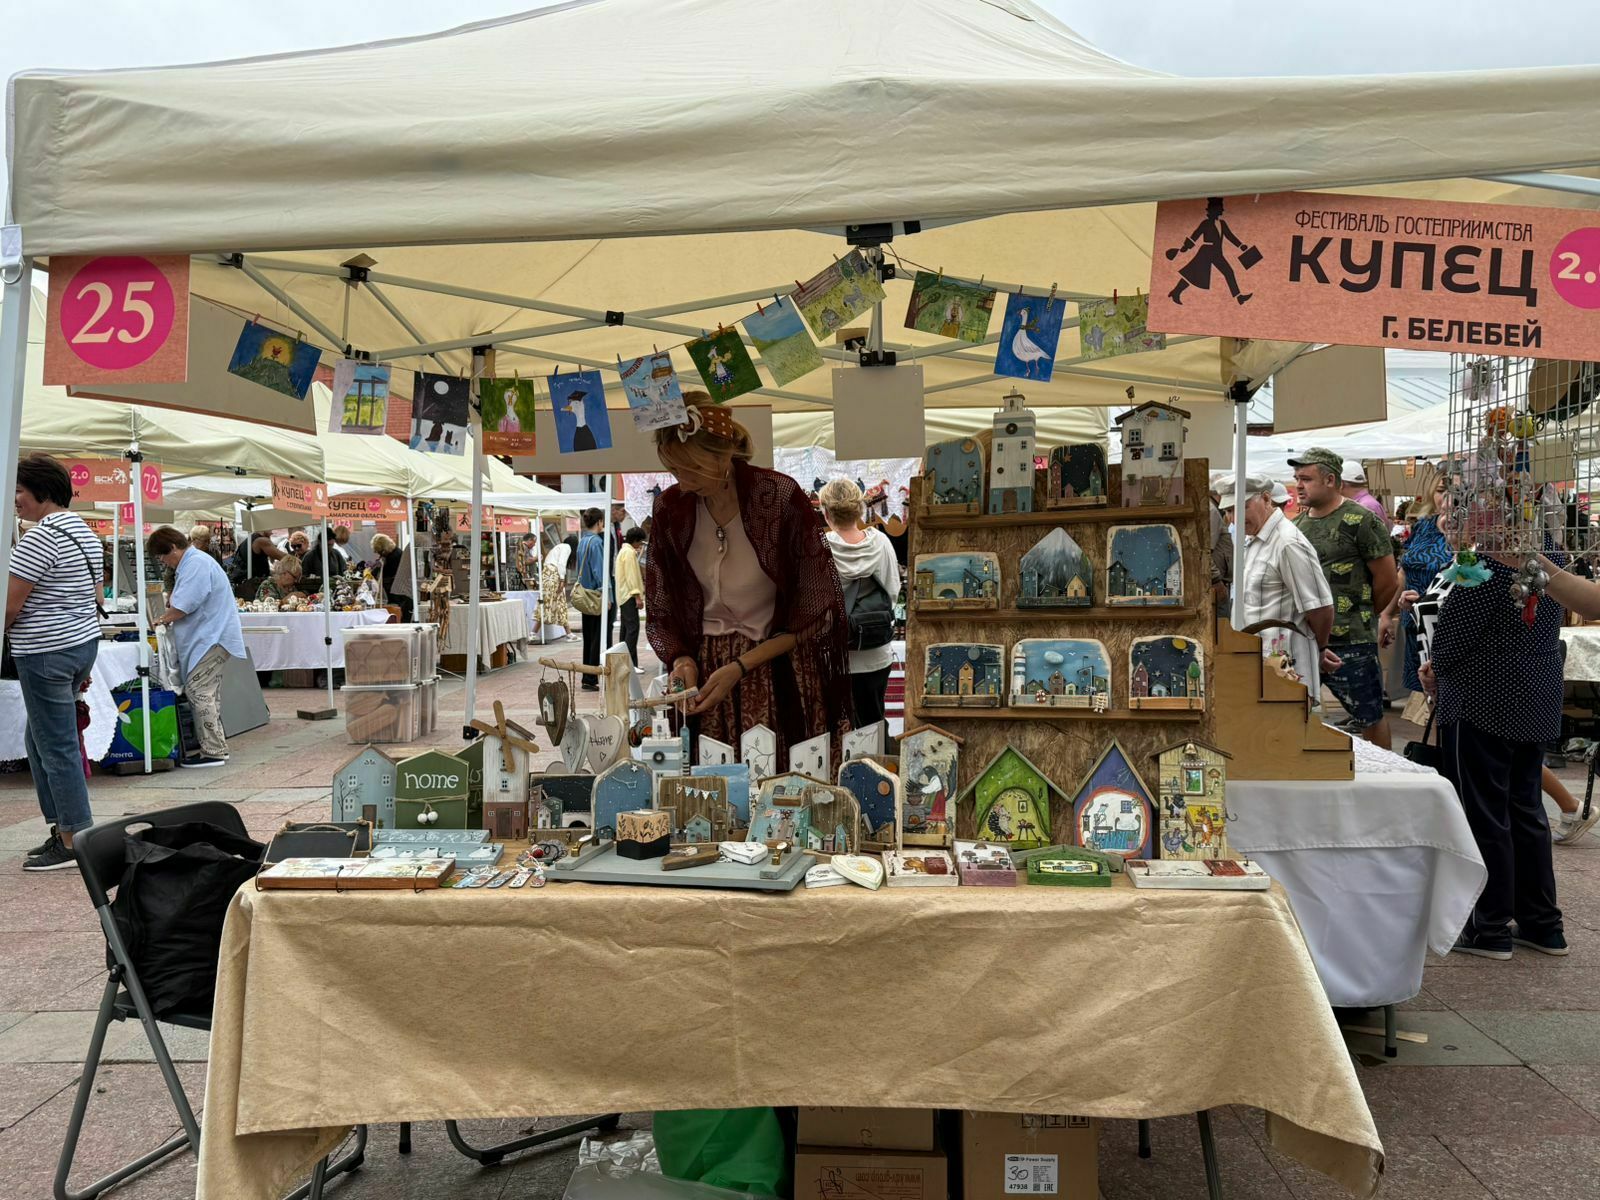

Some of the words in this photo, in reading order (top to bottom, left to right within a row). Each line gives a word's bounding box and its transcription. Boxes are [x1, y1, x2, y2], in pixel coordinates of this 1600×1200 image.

[1295, 210, 1389, 233] ФЕСТИВАЛЬ
[1394, 216, 1533, 242] ГОСТЕПРИИМСТВА
[1288, 235, 1538, 307] КУПЕЦ
[1558, 251, 1600, 284] 2.
[71, 281, 155, 344] 25
[1382, 315, 1398, 339] Г.
[1408, 317, 1542, 348] БЕЛЕБЕЙ
[71, 471, 88, 480] 2.0
[143, 473, 158, 493] 72
[281, 486, 304, 501] КУПЕЦ
[1008, 1165, 1028, 1180] 30
